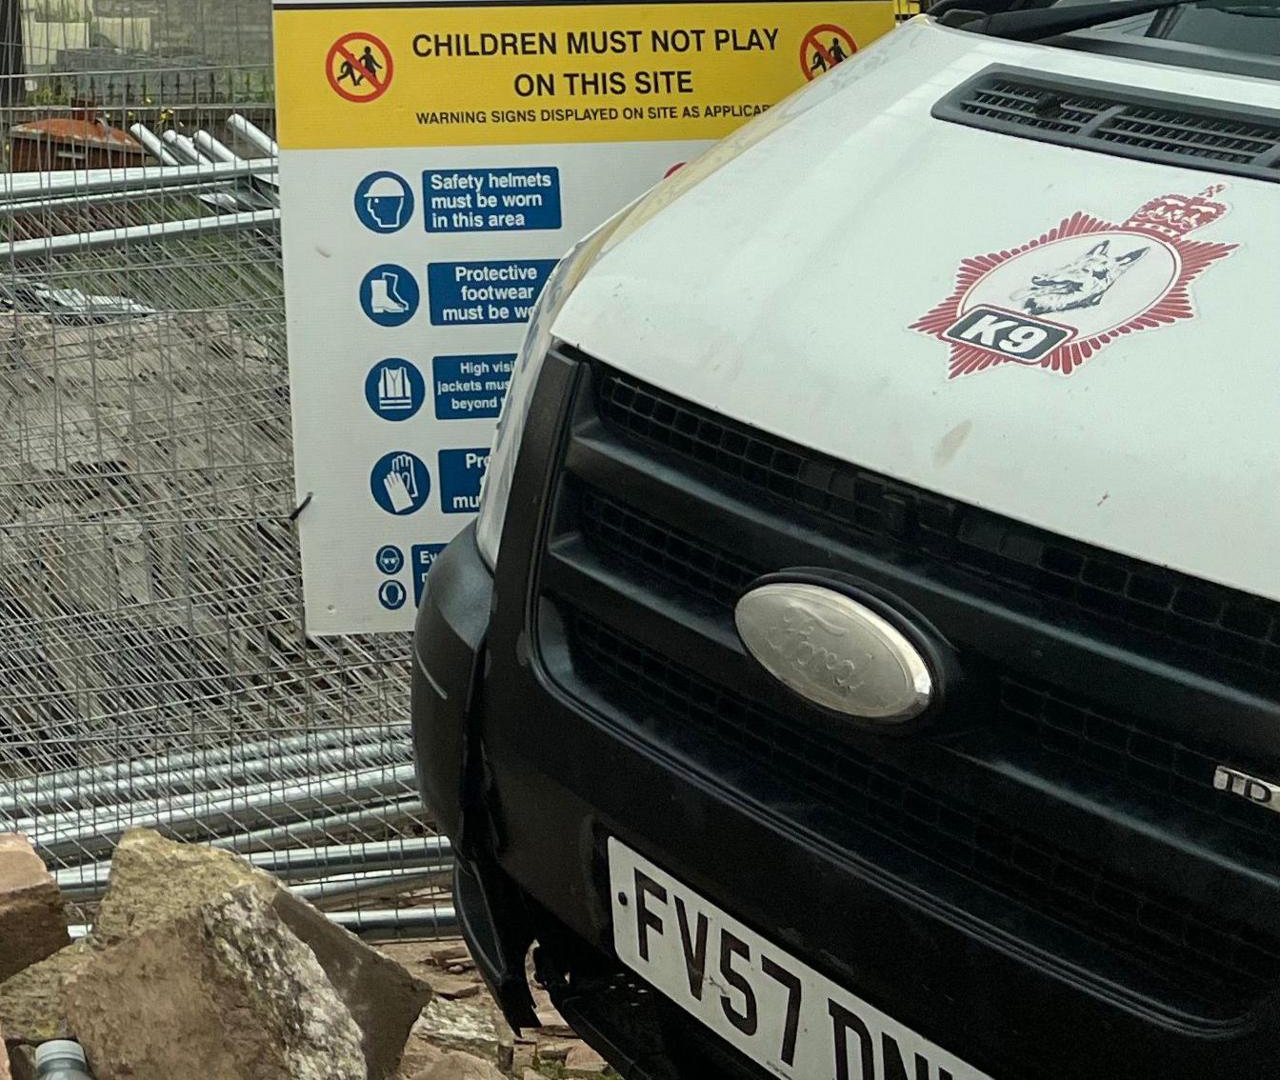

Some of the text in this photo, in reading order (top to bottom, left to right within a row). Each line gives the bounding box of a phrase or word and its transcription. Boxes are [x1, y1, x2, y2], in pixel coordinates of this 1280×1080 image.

[411, 27, 781, 58] CHILDREN MUST NOT PLAY
[513, 70, 694, 97] ON THIS SITE
[415, 110, 487, 125] WARNING
[490, 109, 537, 124] SIGNS
[540, 108, 619, 123] DISPLAYED
[623, 107, 644, 121] ON
[647, 106, 678, 120] SITE
[681, 106, 701, 119] AS
[430, 172, 552, 192] Safety helmets
[431, 193, 543, 209] must be worn
[431, 212, 525, 228] in this area
[455, 264, 538, 282] Protective
[461, 285, 535, 300] footwear
[442, 305, 484, 321] must
[488, 304, 510, 319] be
[960, 314, 1048, 354] K9
[460, 361, 490, 376] High
[437, 380, 482, 395] jackets
[451, 396, 498, 412] beyond
[453, 495, 480, 509] mu
[633, 866, 803, 1068] FV57
